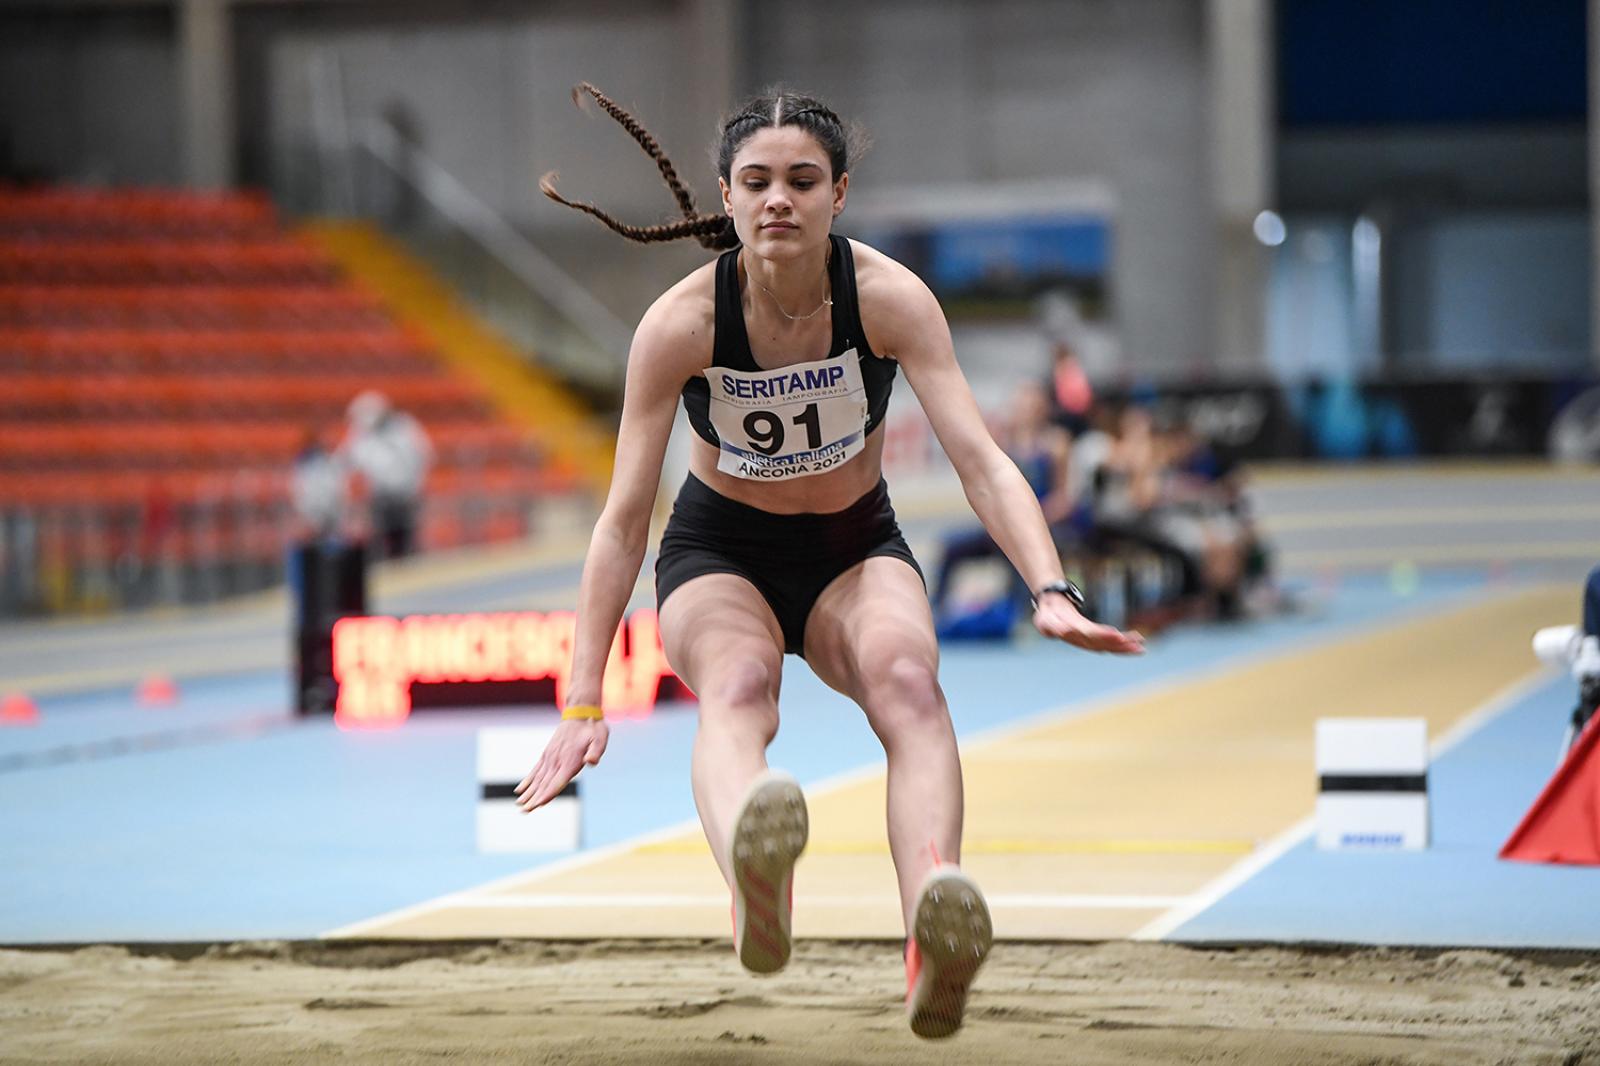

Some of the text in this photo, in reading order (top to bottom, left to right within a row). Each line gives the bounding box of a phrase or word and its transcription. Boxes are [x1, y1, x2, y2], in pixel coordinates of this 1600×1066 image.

[721, 365, 844, 399] SERITAMP
[782, 387, 849, 401] TAMPOGRAFIA
[742, 402, 823, 456] 91
[738, 451, 847, 478] ANCONA 2021
[741, 441, 844, 467] atletica italiana
